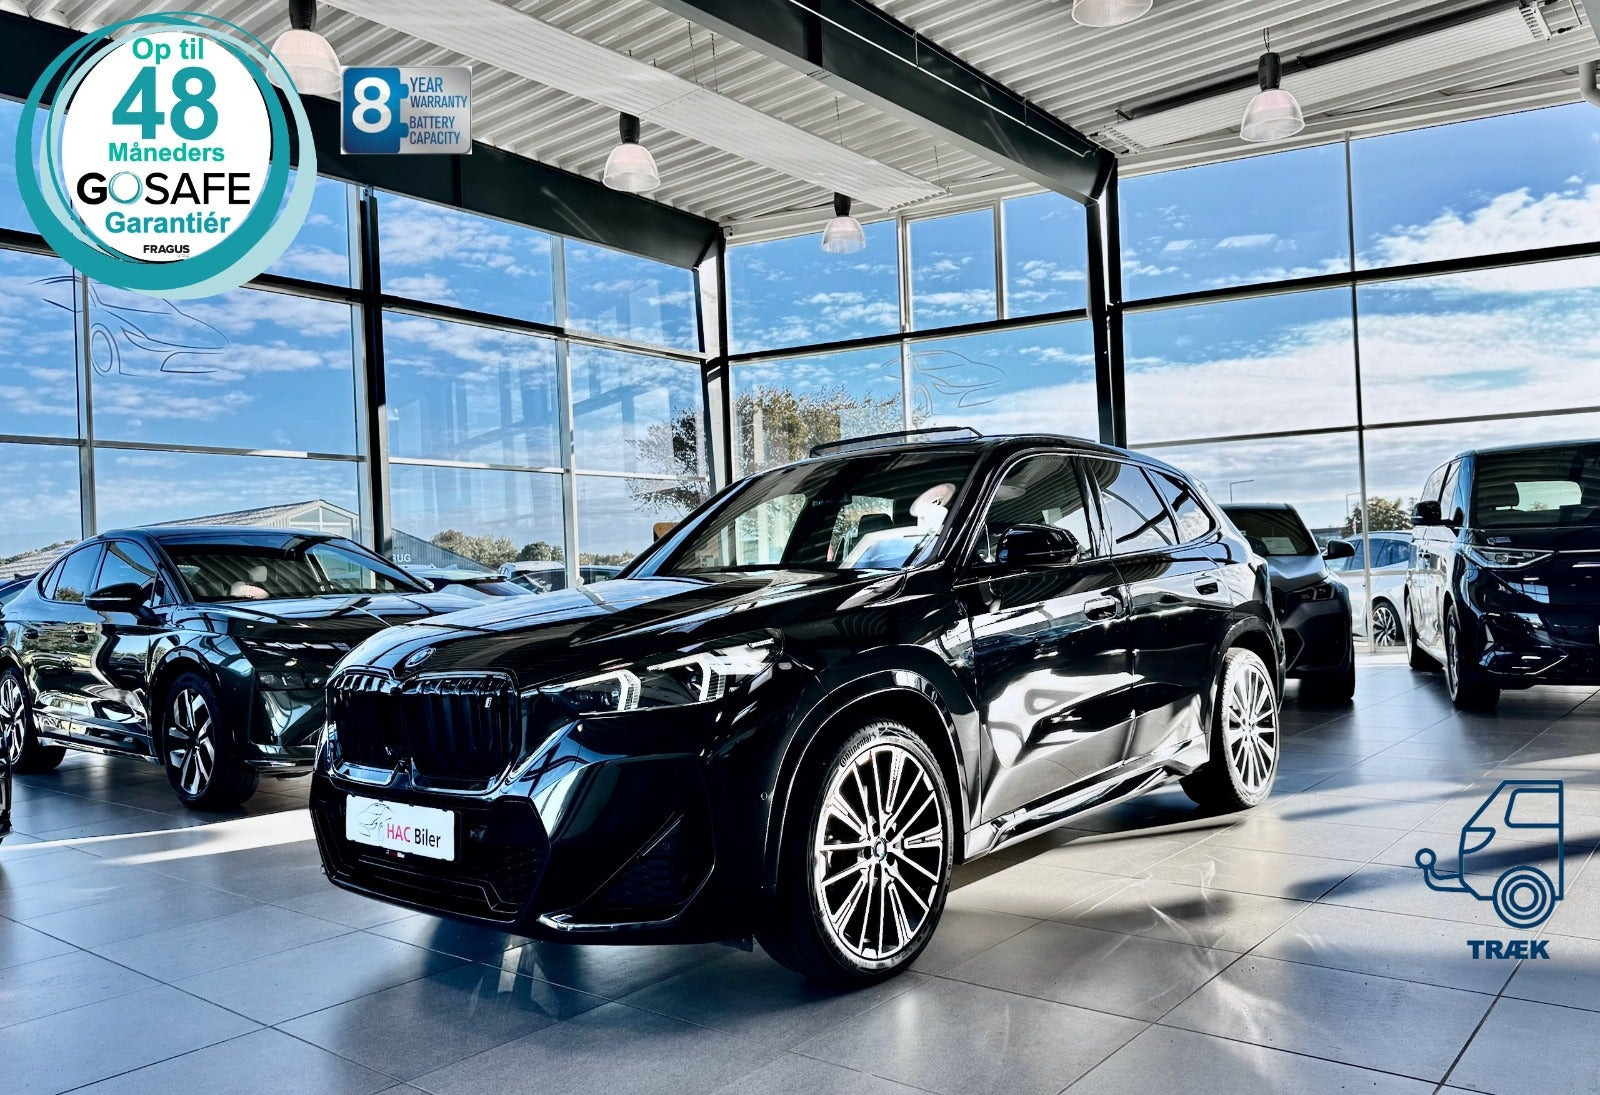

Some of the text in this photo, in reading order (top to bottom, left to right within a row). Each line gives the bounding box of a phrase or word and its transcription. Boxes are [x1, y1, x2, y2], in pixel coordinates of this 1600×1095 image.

[839, 733, 871, 767] Continental
[387, 823, 442, 848] HAC Biler
